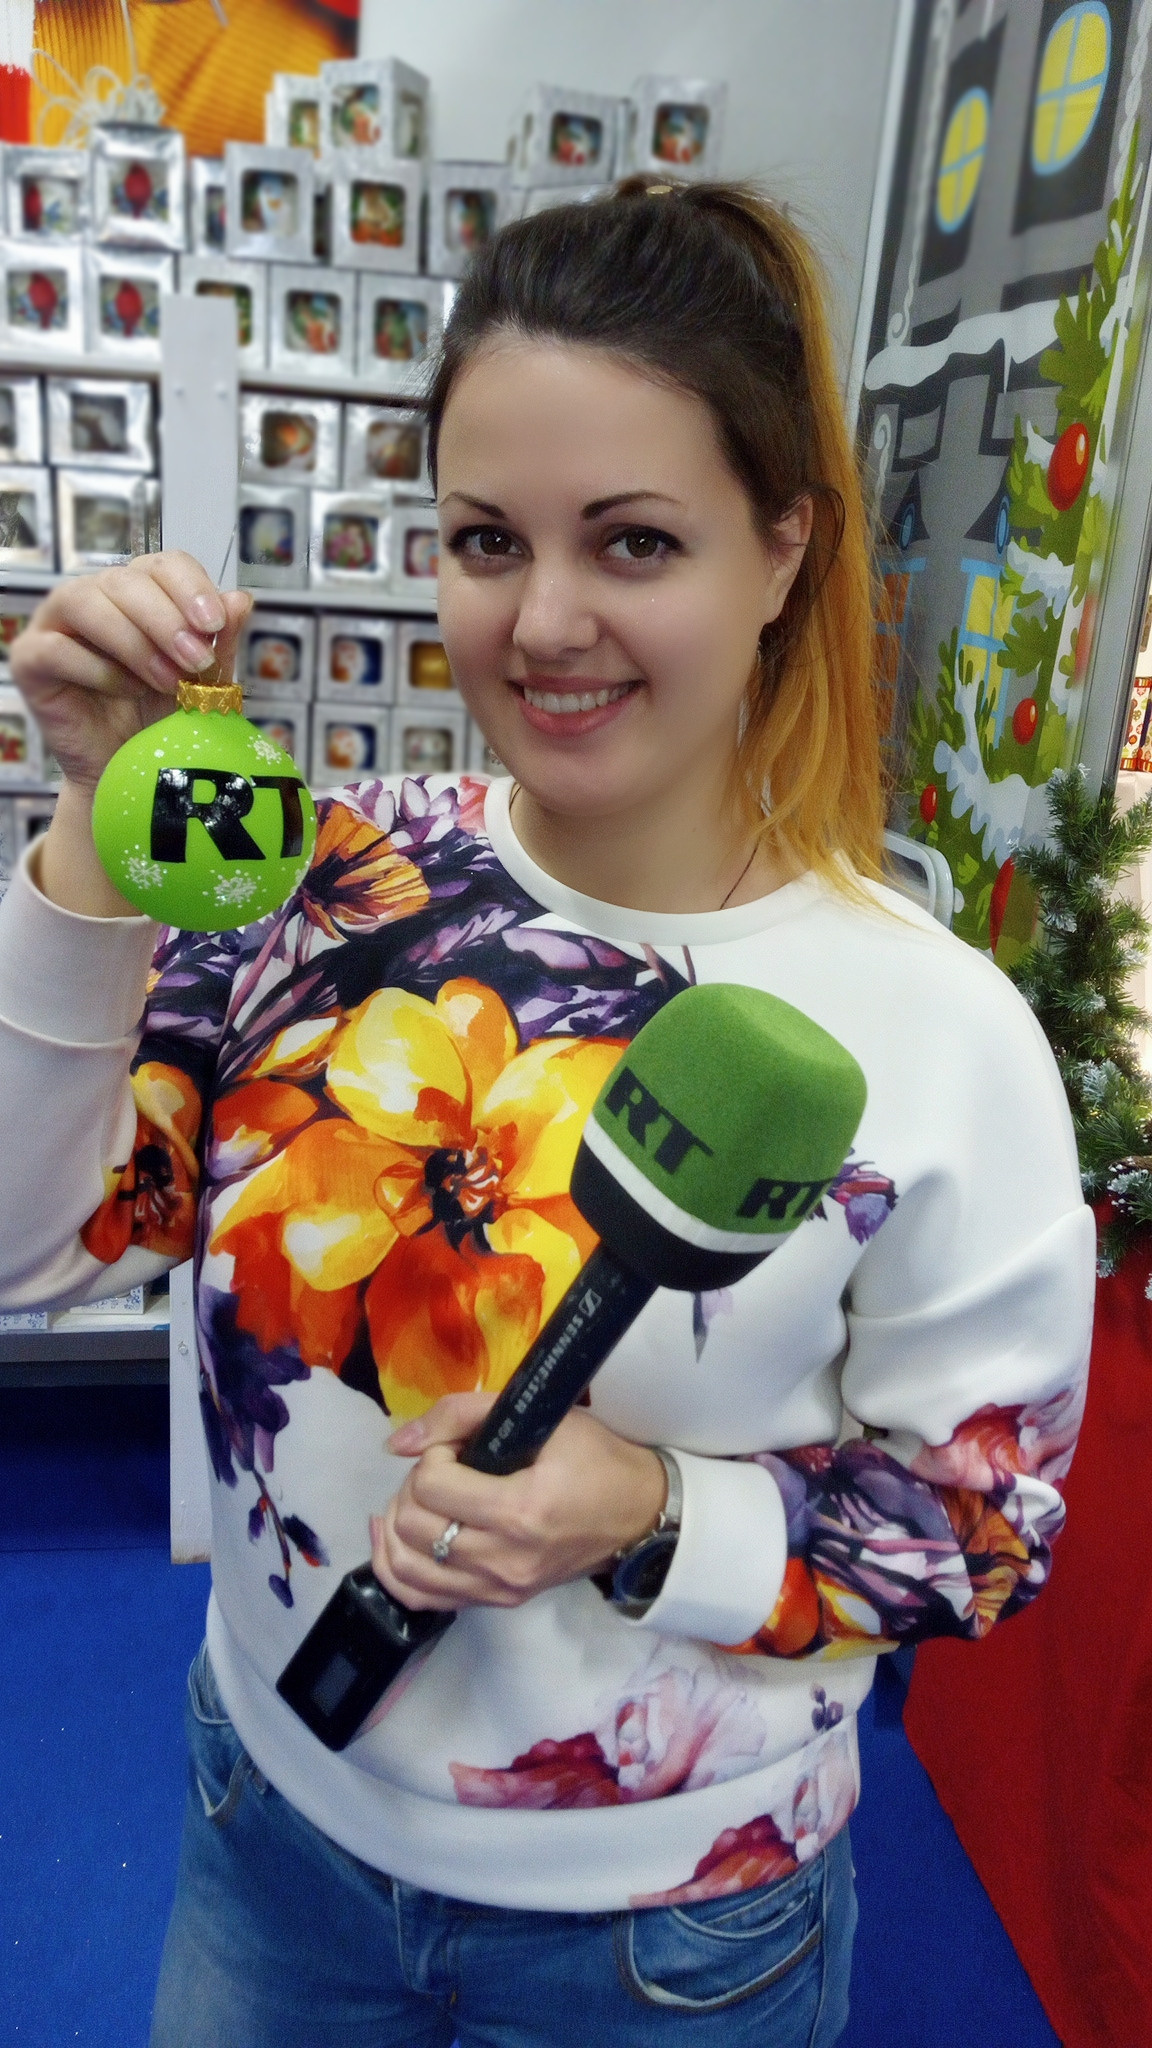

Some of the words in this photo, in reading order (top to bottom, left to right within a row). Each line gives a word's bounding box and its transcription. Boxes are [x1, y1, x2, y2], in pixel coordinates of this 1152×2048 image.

[151, 767, 306, 863] RT
[604, 1066, 714, 1175] RT
[736, 1178, 833, 1219] RT
[515, 1315, 584, 1414] SENNHEISER
